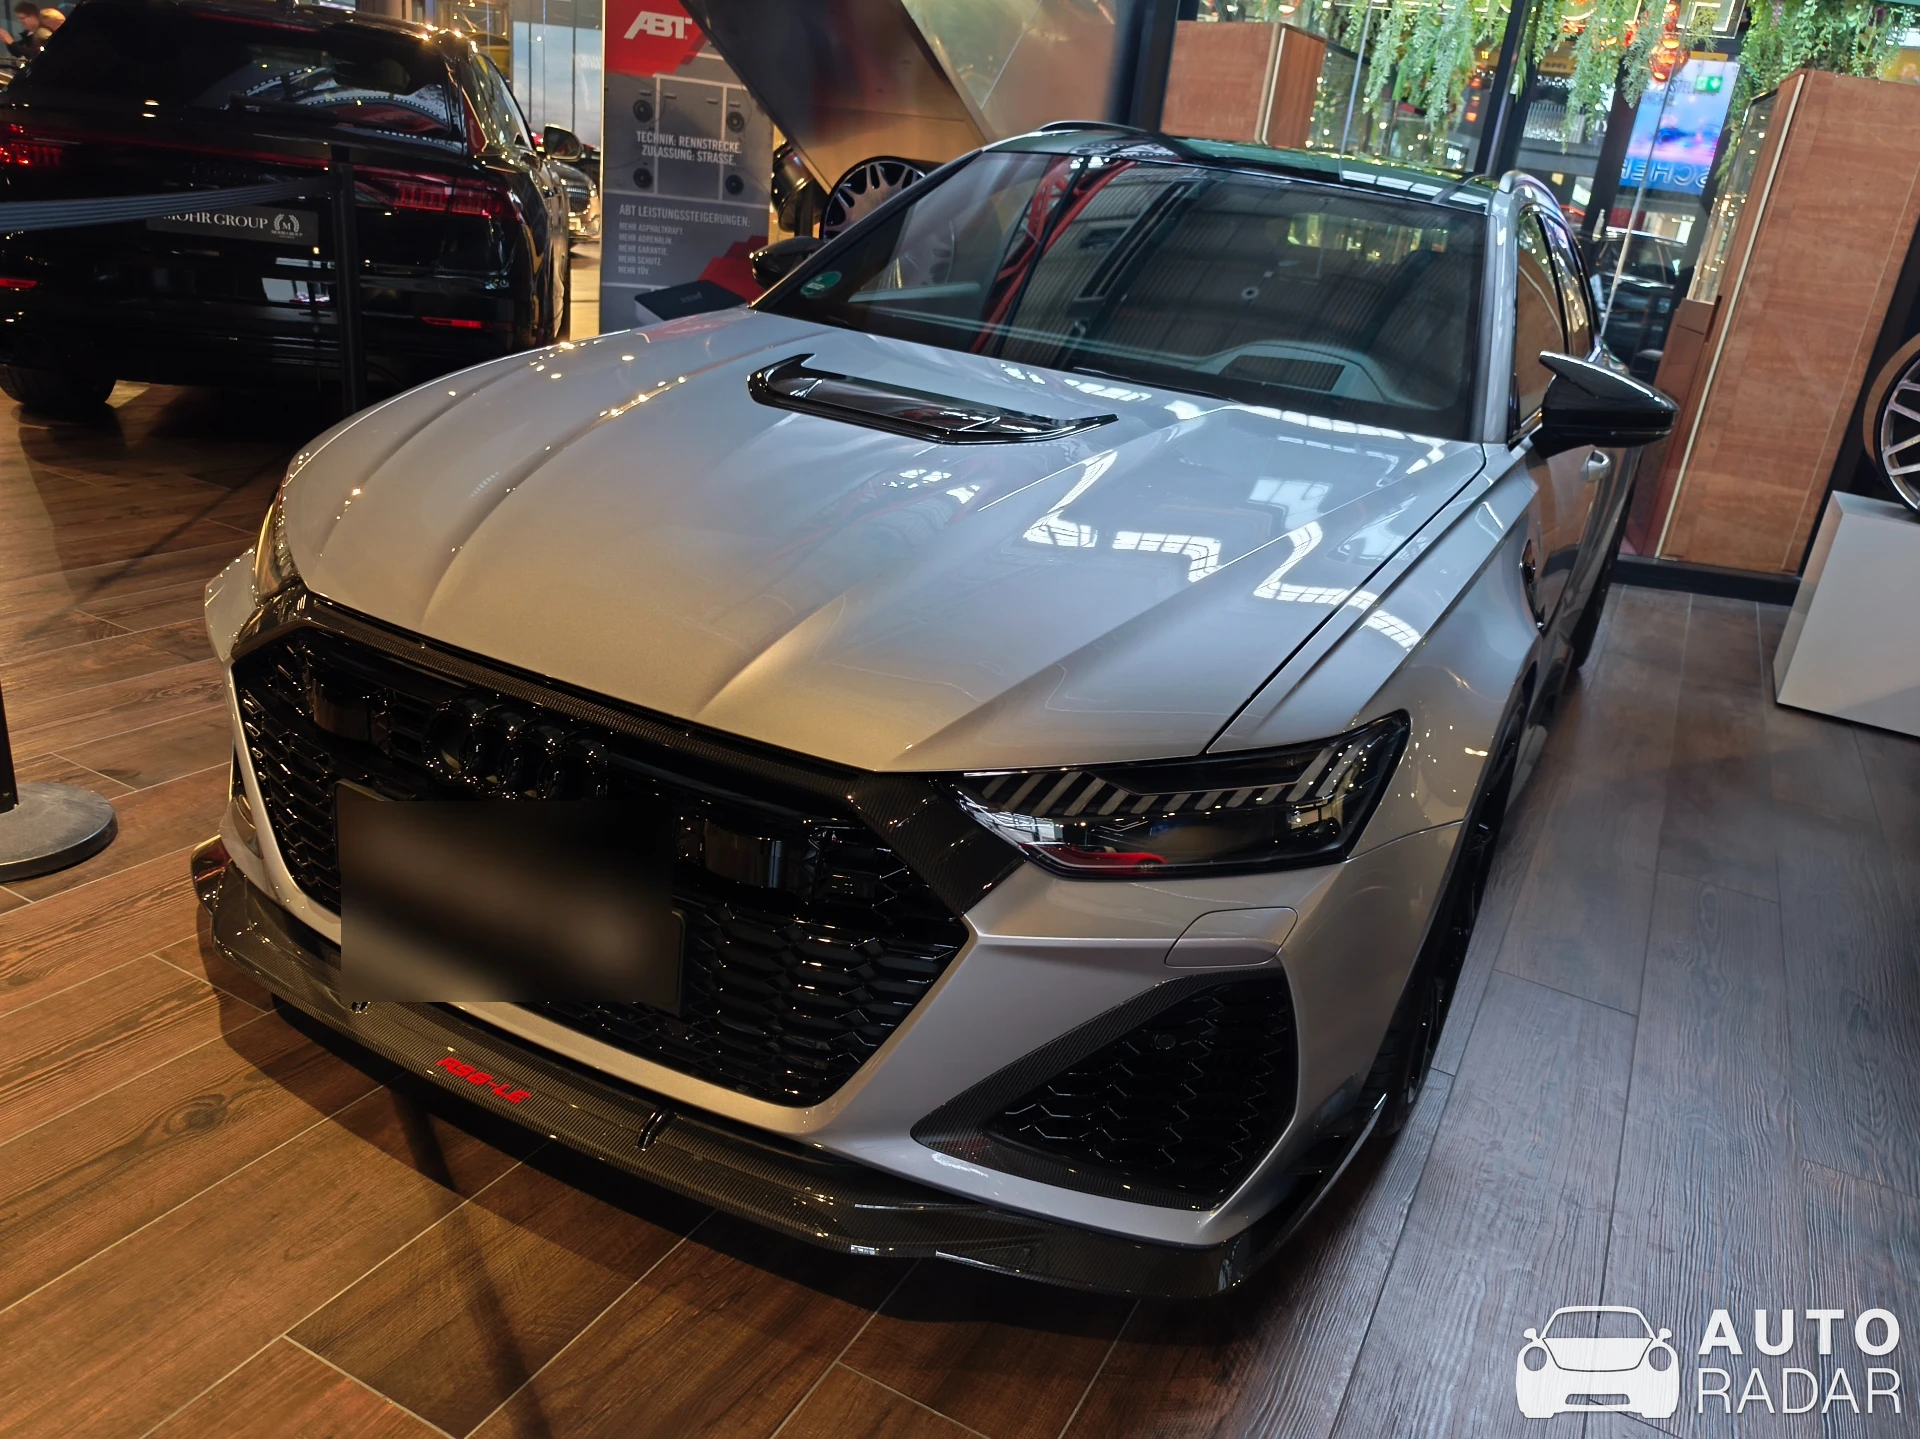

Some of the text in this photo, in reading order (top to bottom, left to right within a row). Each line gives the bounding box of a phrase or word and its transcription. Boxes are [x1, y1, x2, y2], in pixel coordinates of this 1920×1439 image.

[624, 11, 692, 39] ABT
[636, 131, 742, 154] TECHNIK: RENNSTRECKE.
[642, 145, 737, 166] ZULASSUNG: STRASSE.
[213, 213, 268, 229] GROUP
[282, 222, 291, 230] M
[619, 204, 750, 227] ABT LEISTUNGSSTEIGERUNGEN:
[436, 1057, 532, 1104] RS6-LE
